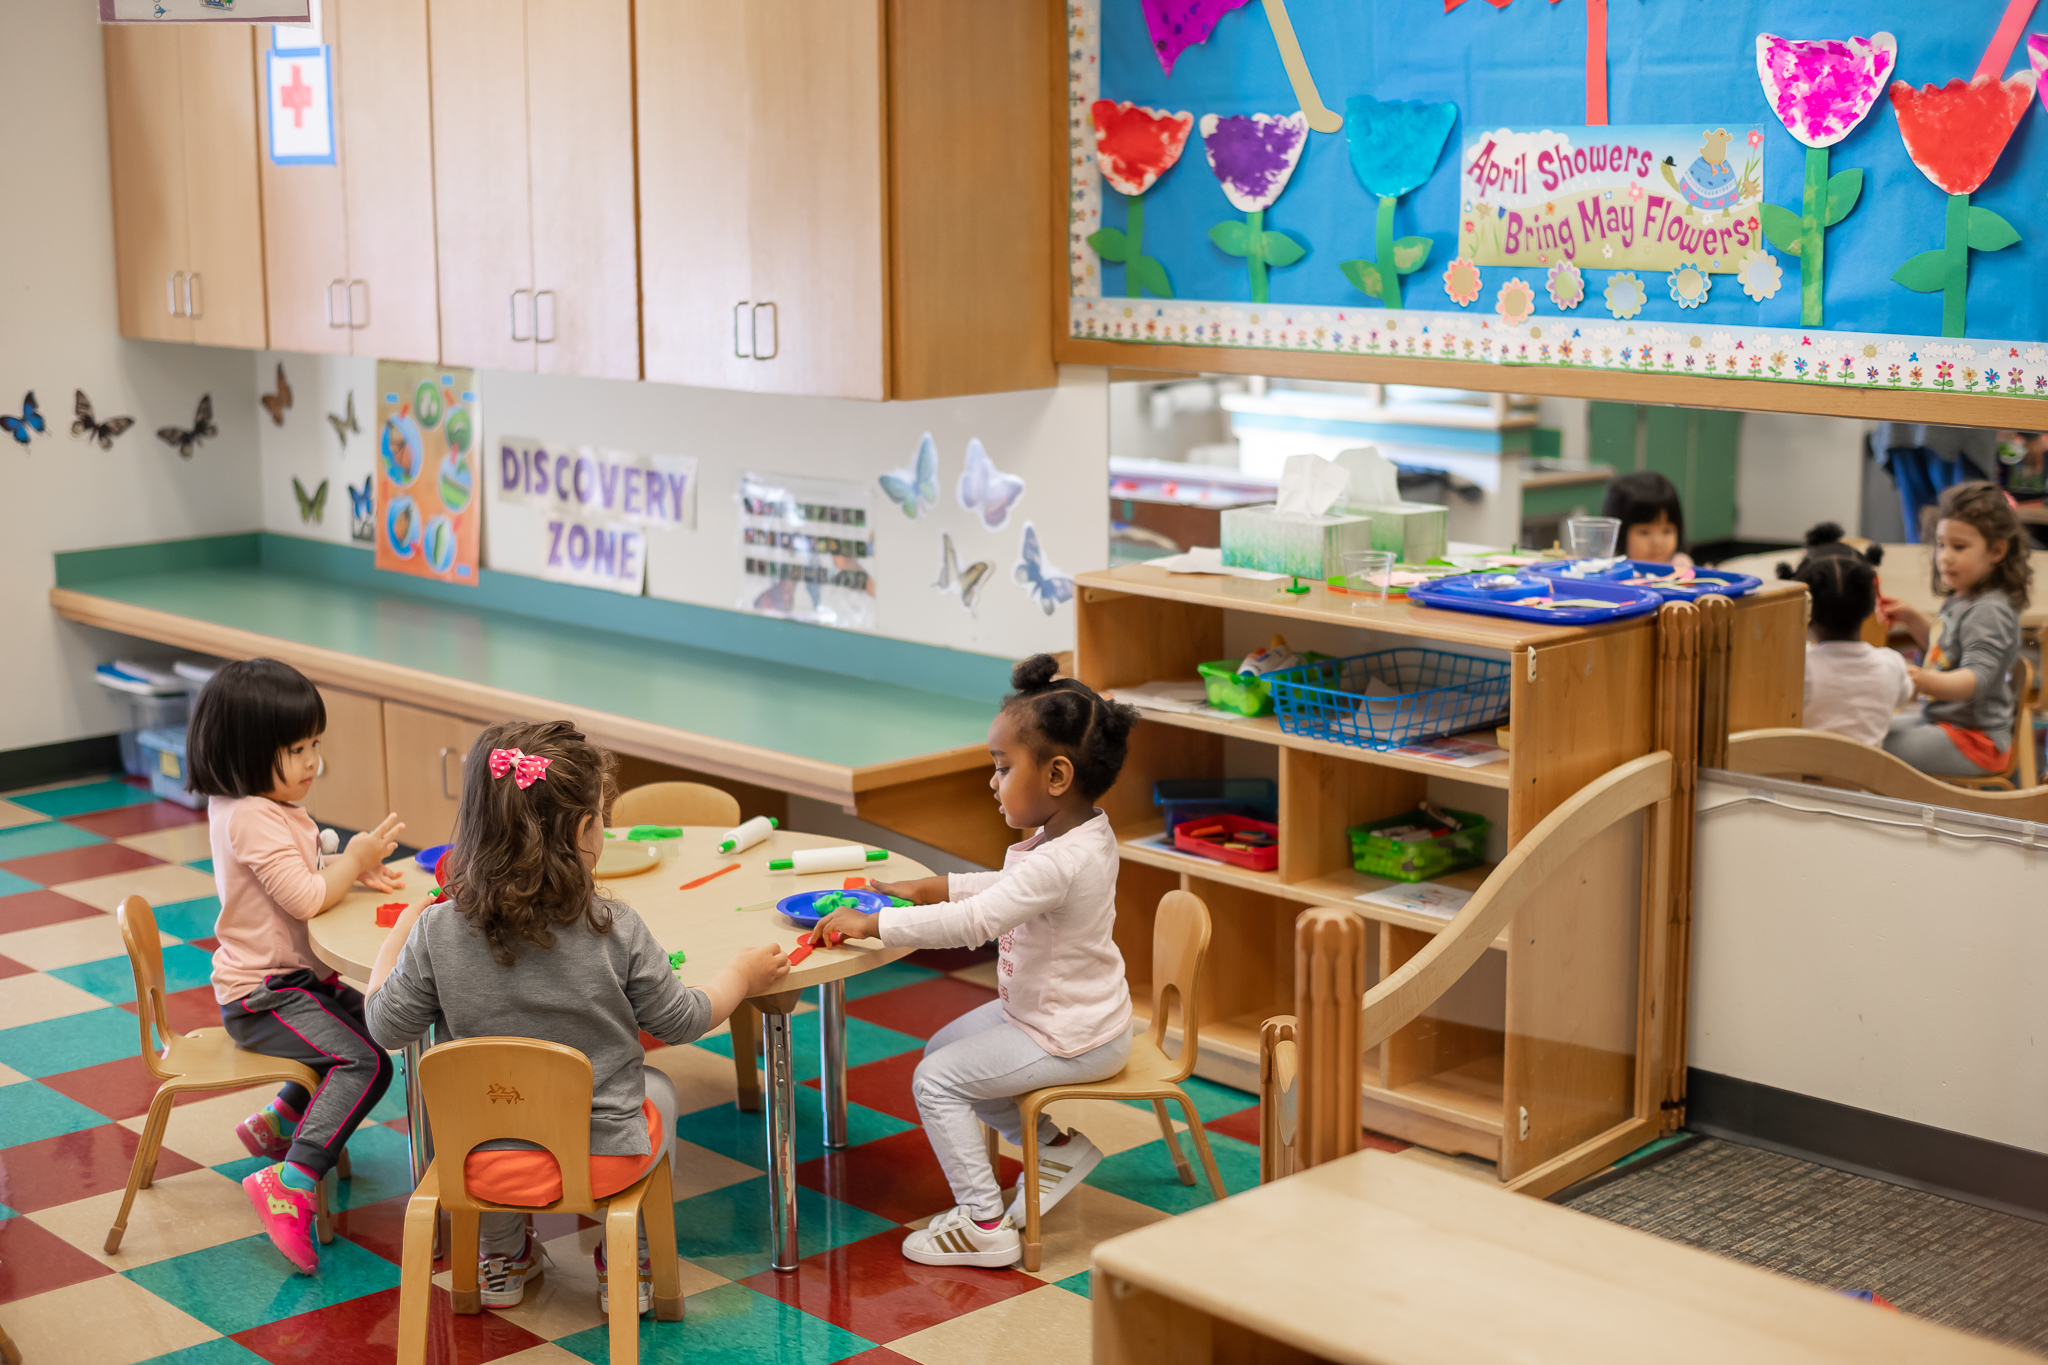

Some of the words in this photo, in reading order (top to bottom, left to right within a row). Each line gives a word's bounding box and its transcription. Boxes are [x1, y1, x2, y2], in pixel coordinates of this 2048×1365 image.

[1466, 139, 1528, 198] April
[1537, 144, 1653, 191] Showers
[1504, 211, 1576, 260] Bring
[1577, 195, 1635, 248] May
[1642, 194, 1750, 256] Flowers
[502, 446, 688, 522] DISCOVERY
[547, 521, 639, 579] ZONE
